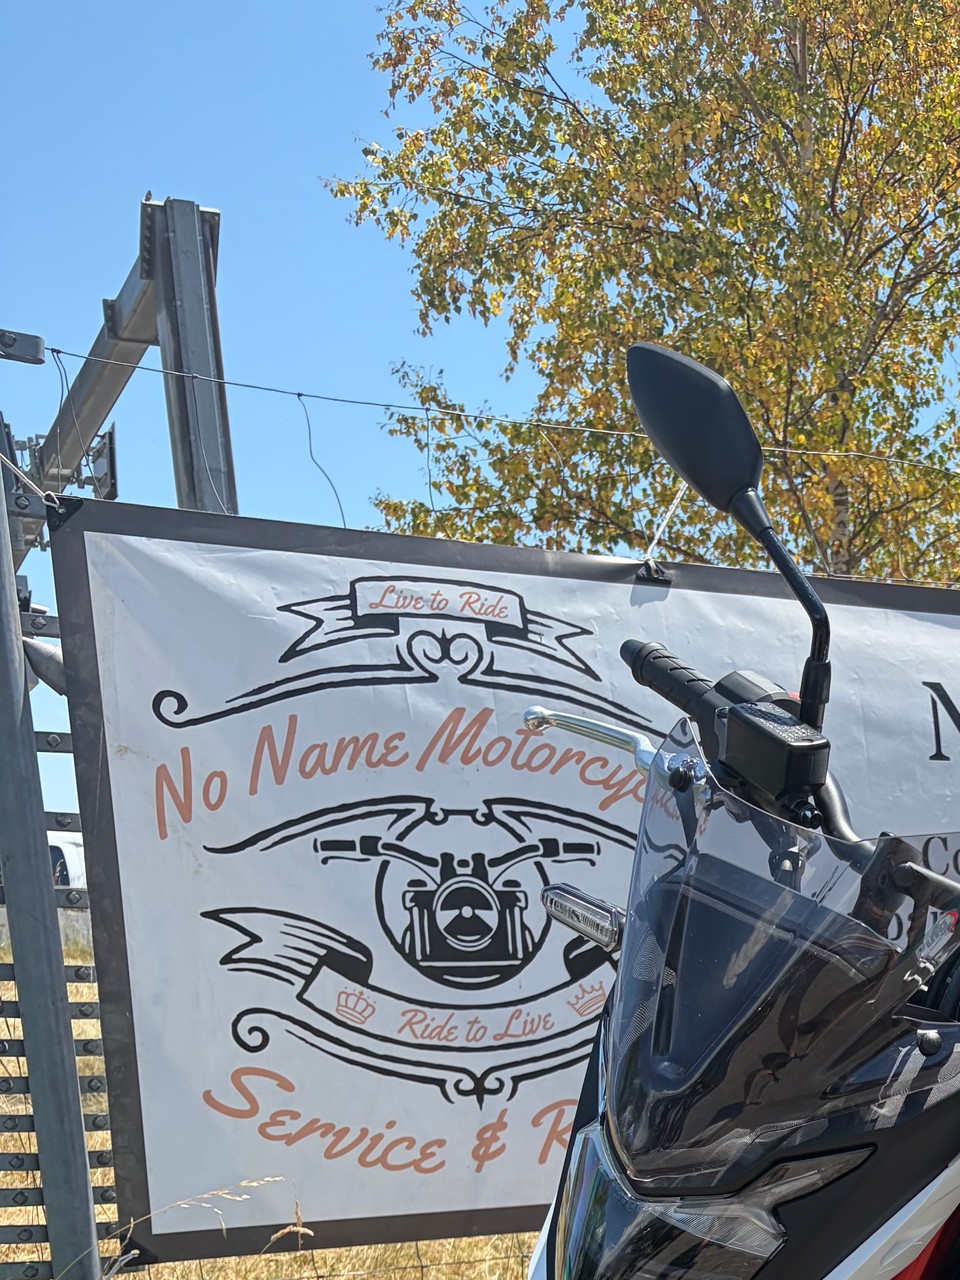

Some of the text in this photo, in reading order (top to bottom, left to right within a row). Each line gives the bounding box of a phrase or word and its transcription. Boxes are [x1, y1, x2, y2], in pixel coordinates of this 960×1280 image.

[368, 585, 509, 619] Live to Ride
[155, 746, 228, 840] No
[248, 714, 408, 796] Name
[397, 1008, 555, 1043] Ride to Live
[202, 1066, 446, 1175] Service
[470, 1108, 507, 1175] &
